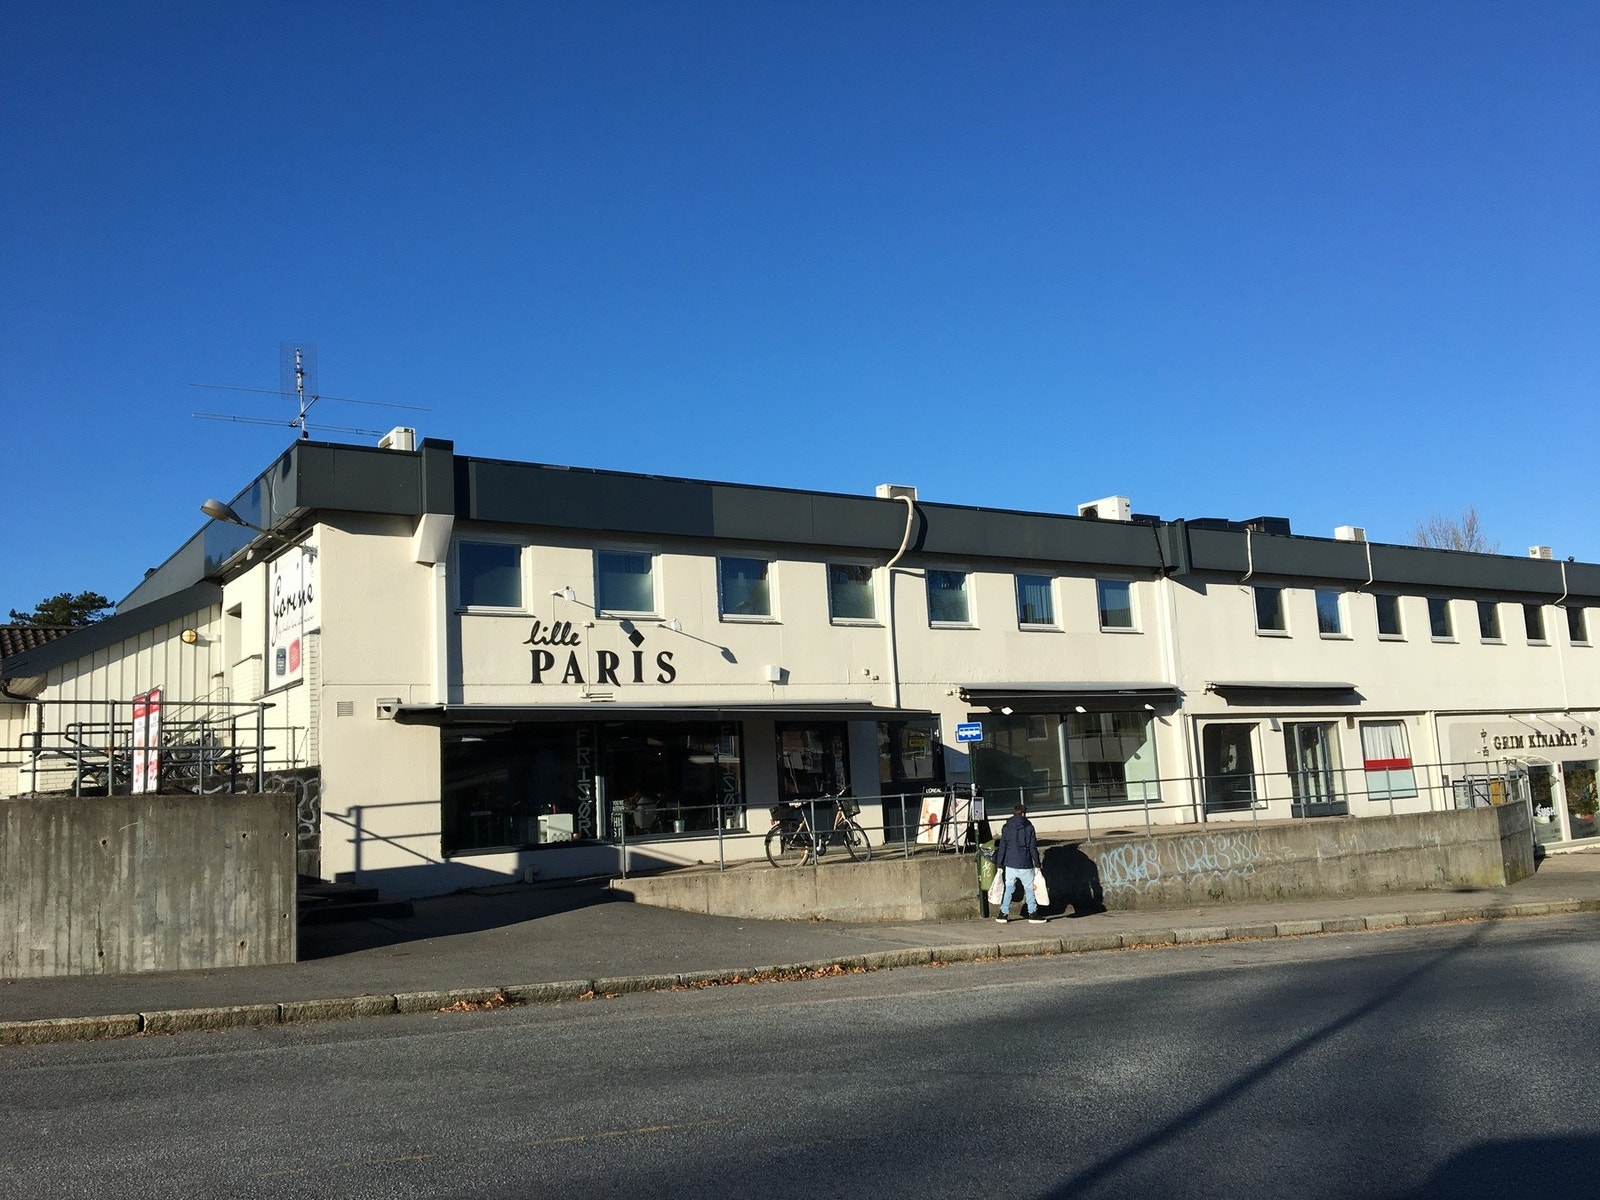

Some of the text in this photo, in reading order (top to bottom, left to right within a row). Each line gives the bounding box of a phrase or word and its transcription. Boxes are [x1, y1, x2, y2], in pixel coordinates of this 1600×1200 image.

[523, 620, 581, 646] lille
[529, 629, 677, 687] PARIS
[1493, 735, 1525, 751] GRIM
[1528, 733, 1578, 748] KINAMAT
[1536, 806, 1557, 818] SUSH
